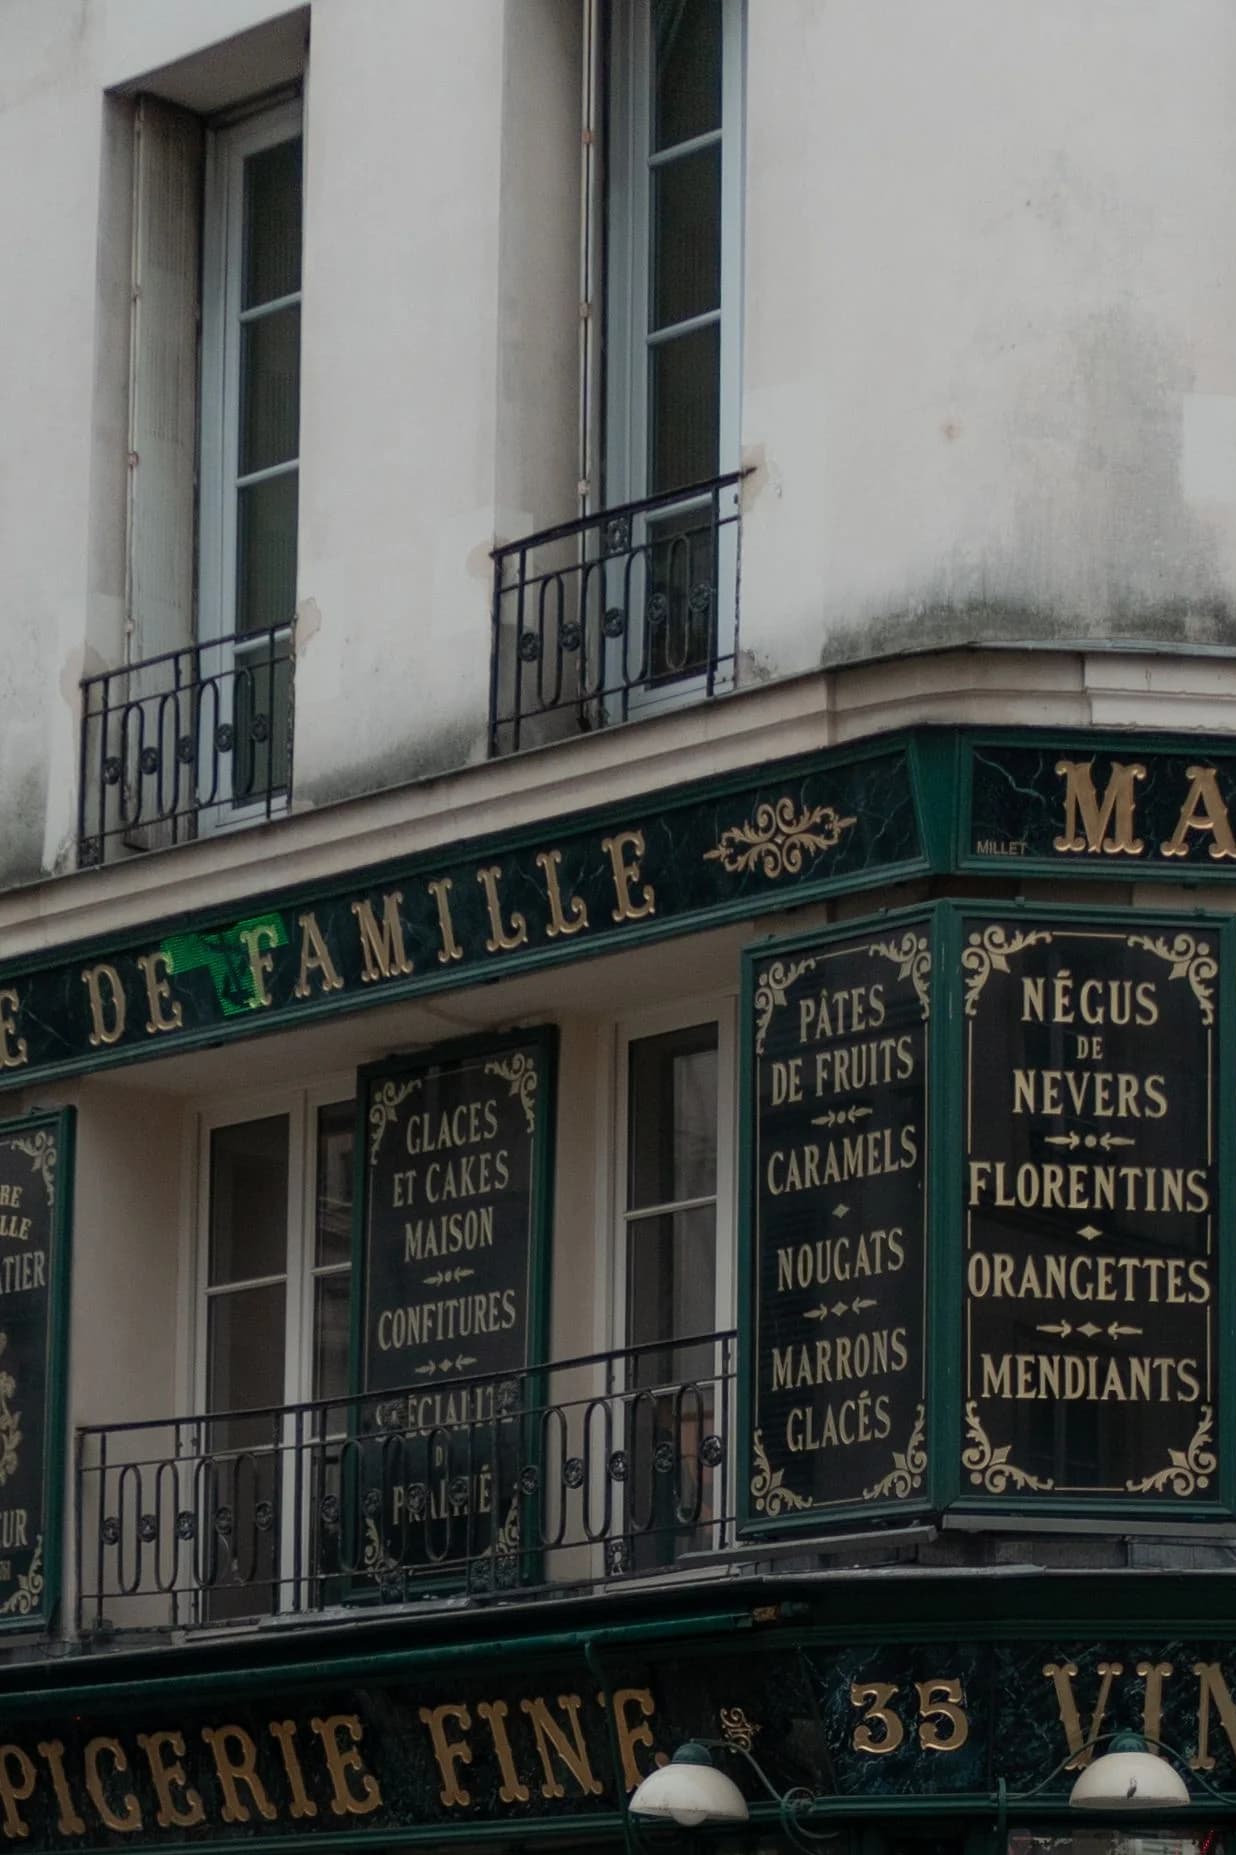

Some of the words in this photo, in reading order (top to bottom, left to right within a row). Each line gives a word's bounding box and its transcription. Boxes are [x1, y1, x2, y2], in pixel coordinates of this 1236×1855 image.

[976, 839, 1027, 856] MILLET
[81, 953, 183, 1046] DE
[240, 830, 656, 1009] FAMILLE
[799, 984, 886, 1044] PÂTES
[1020, 969, 1160, 1026] NÉGUS
[771, 1057, 804, 1106] DE
[815, 1035, 914, 1097] FRUITS
[1076, 1035, 1103, 1061] DE
[1011, 1069, 1168, 1119] NEVERS
[406, 1100, 498, 1155] GLACES
[392, 1169, 420, 1208] ET
[425, 1150, 511, 1202] CAKES
[767, 1124, 919, 1196] CARAMELS
[969, 1161, 1209, 1214] FLORENTINS
[404, 1206, 495, 1263] MAISON
[776, 1226, 905, 1292] NOUGATS
[968, 1251, 1211, 1304] ORANGETTES
[377, 1289, 517, 1352] CONFITURES
[771, 1326, 909, 1393] MARRONS
[981, 1352, 1200, 1403] MENDIANTS
[786, 1389, 891, 1453] GLACÉS
[850, 1677, 971, 1755] 35
[418, 1688, 658, 1808] FINE
